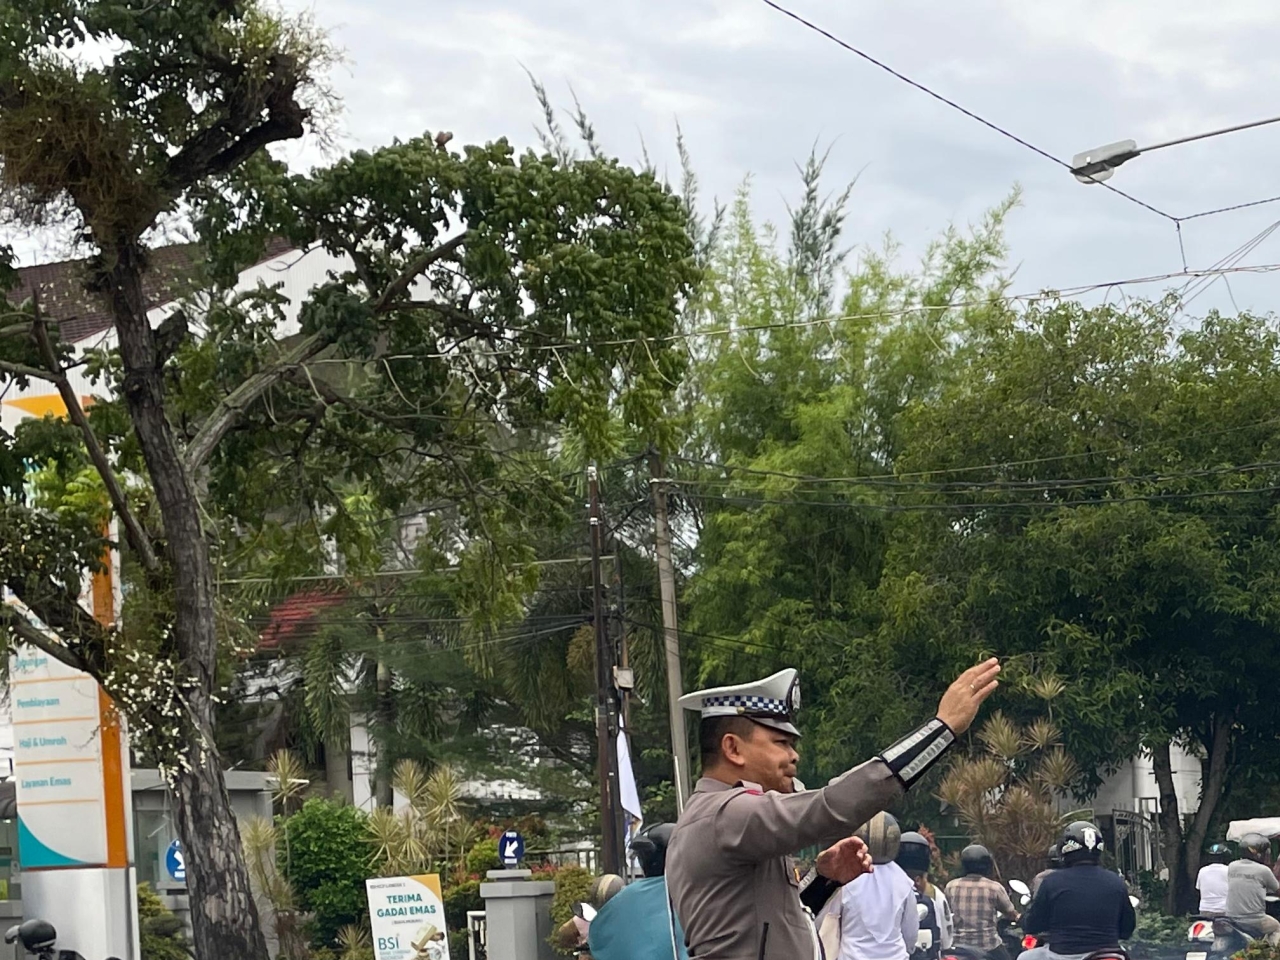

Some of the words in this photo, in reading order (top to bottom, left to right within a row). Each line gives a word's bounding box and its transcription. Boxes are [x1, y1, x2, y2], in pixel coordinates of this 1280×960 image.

[50, 777, 72, 787] Emas
[386, 893, 423, 904] TERIMA
[377, 907, 408, 918] GADAI
[410, 905, 437, 916] EMAS
[378, 937, 400, 951] BSI
